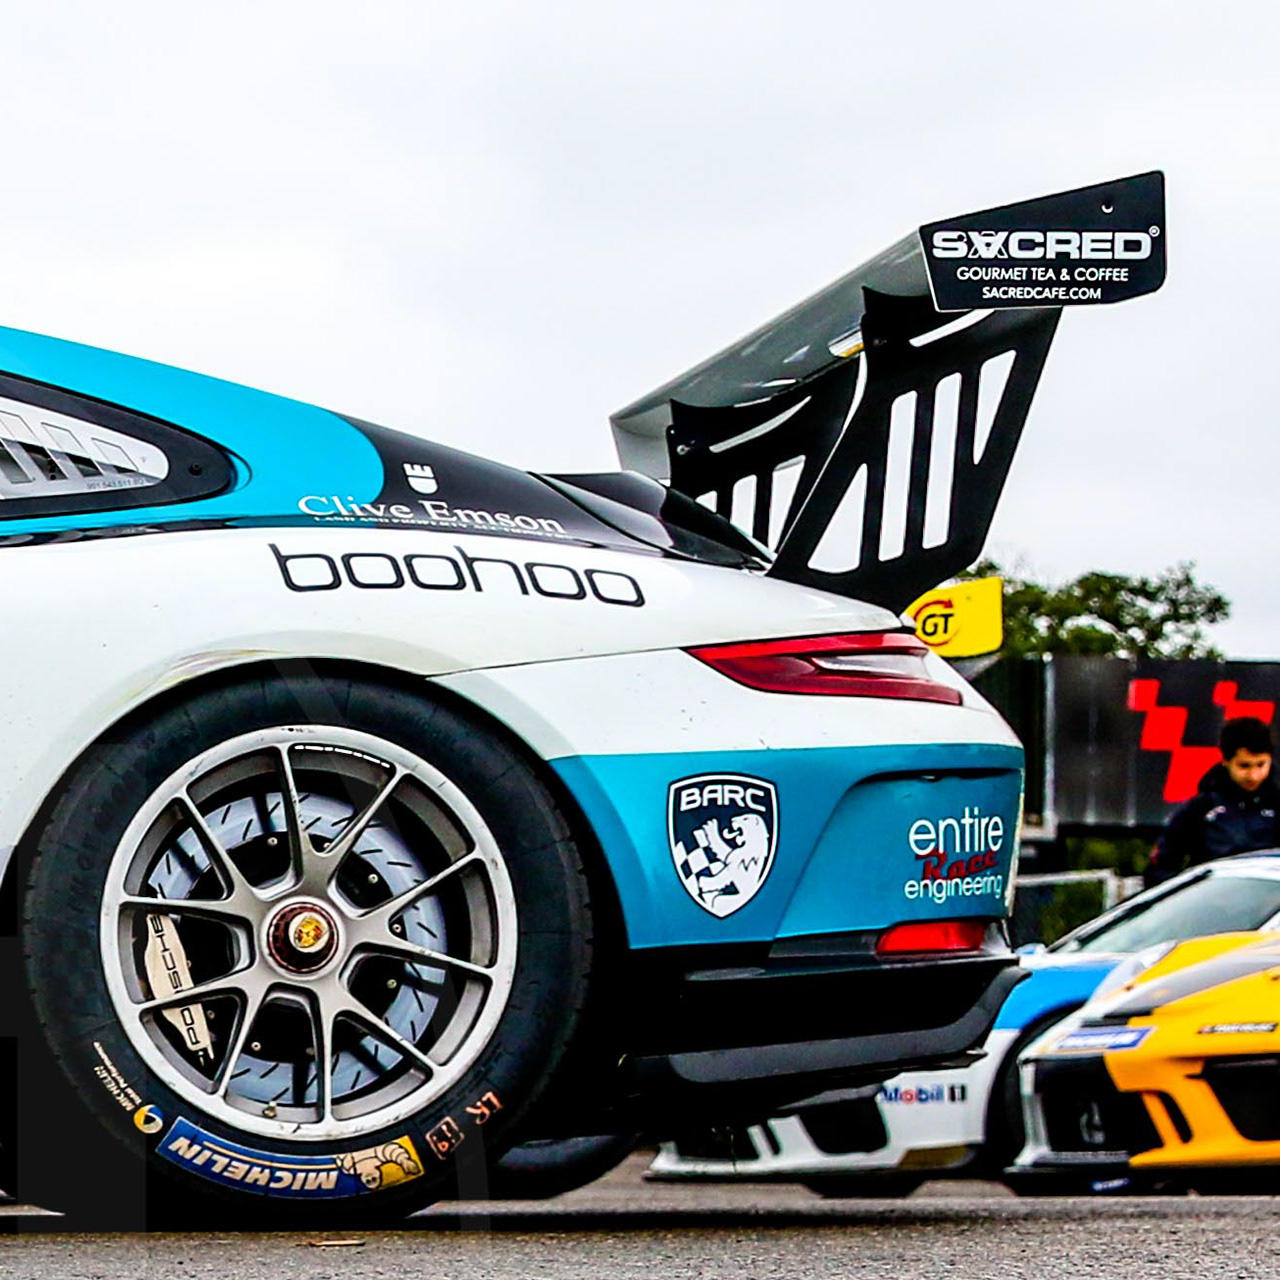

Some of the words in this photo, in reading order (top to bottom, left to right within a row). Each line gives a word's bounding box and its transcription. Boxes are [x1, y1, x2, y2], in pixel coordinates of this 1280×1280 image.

[956, 266, 1028, 282] GOURMET
[1031, 267, 1056, 281] TEA
[1059, 268, 1071, 281] &
[1074, 267, 1129, 282] COFFEE
[981, 286, 1102, 300] SACREDCAFE.COM
[298, 495, 414, 519] Clive
[418, 500, 567, 535] Emson
[267, 541, 647, 608] boohoo
[678, 784, 767, 813] BARC
[908, 805, 1005, 856] entire
[904, 872, 1003, 903] engineering
[168, 1135, 340, 1191] MICHELIN
